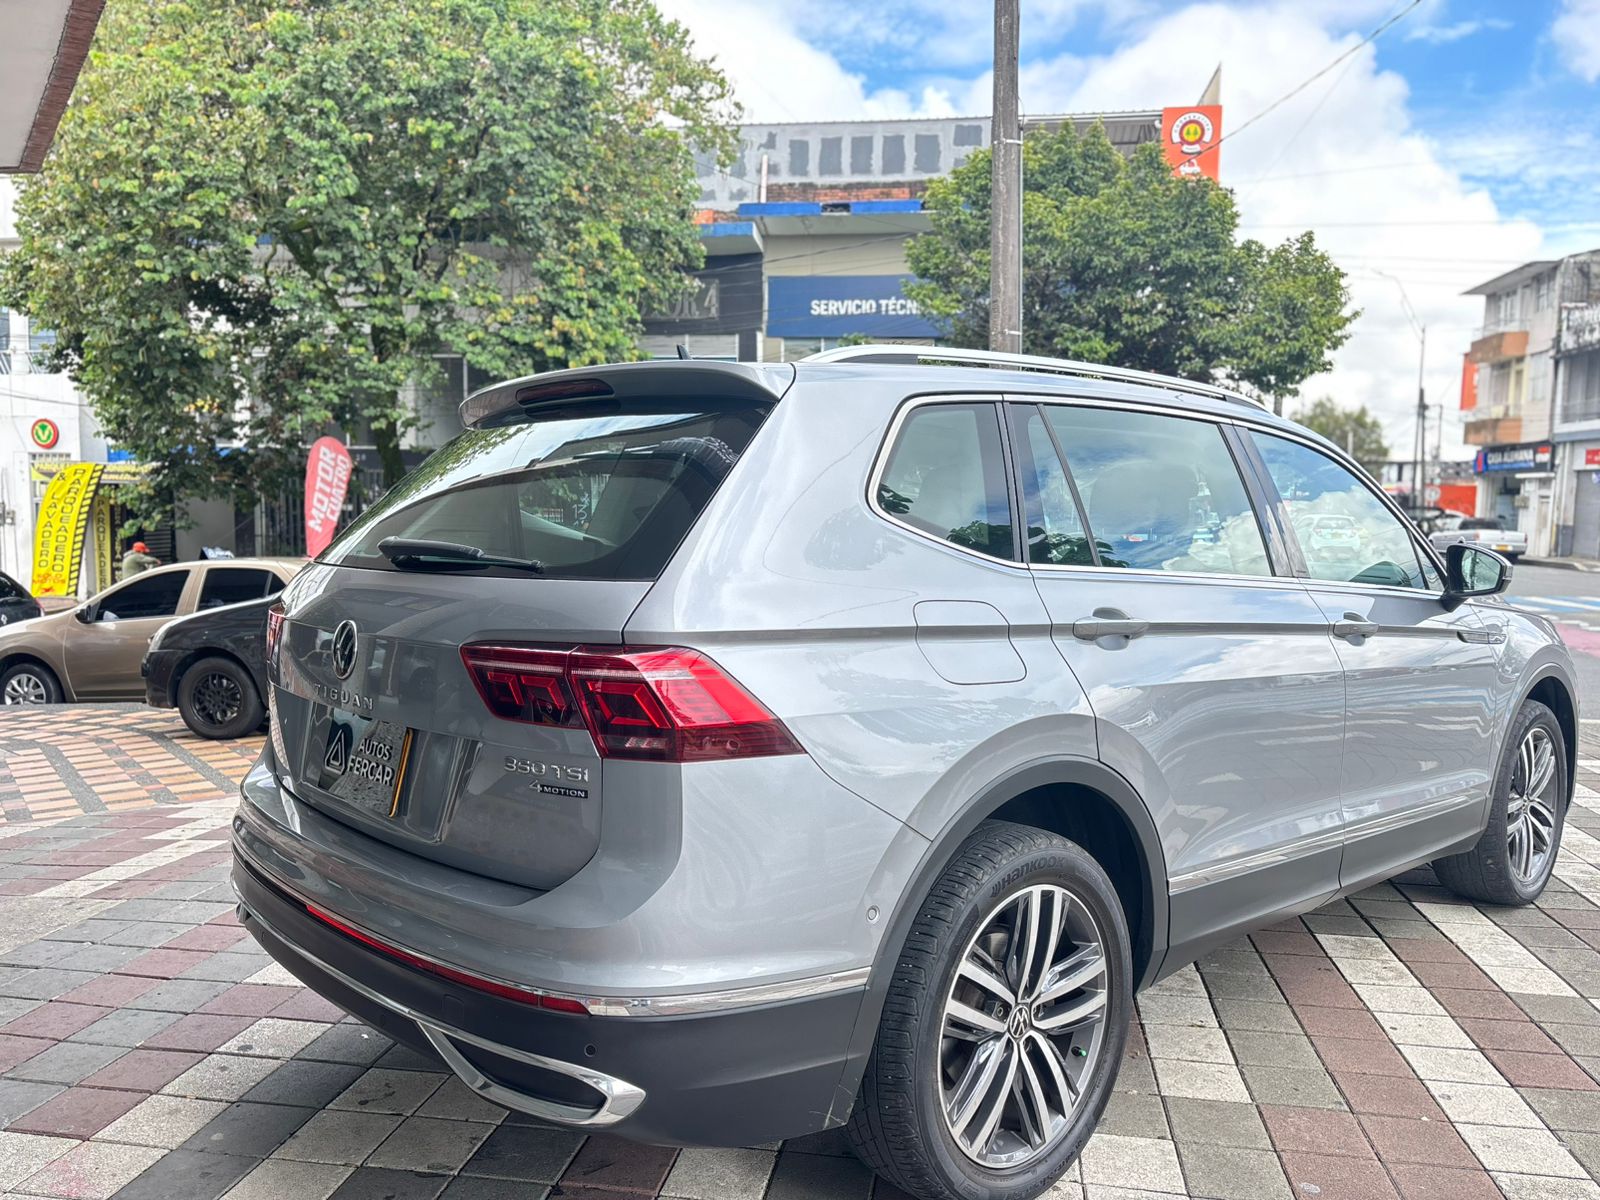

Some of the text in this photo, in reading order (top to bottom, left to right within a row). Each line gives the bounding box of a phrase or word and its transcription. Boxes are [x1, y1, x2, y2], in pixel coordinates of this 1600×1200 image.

[810, 295, 920, 316] SERVICIO TÉCN
[307, 446, 337, 532] MOTOR
[326, 454, 350, 522] CUATRO
[38, 491, 60, 568] LAVADERO
[52, 468, 86, 572] PARQUEADERO
[314, 683, 374, 710] TIGUAN
[357, 738, 394, 761] AUTOS
[347, 754, 395, 787] FERCAR
[503, 756, 589, 782] 350 TSI
